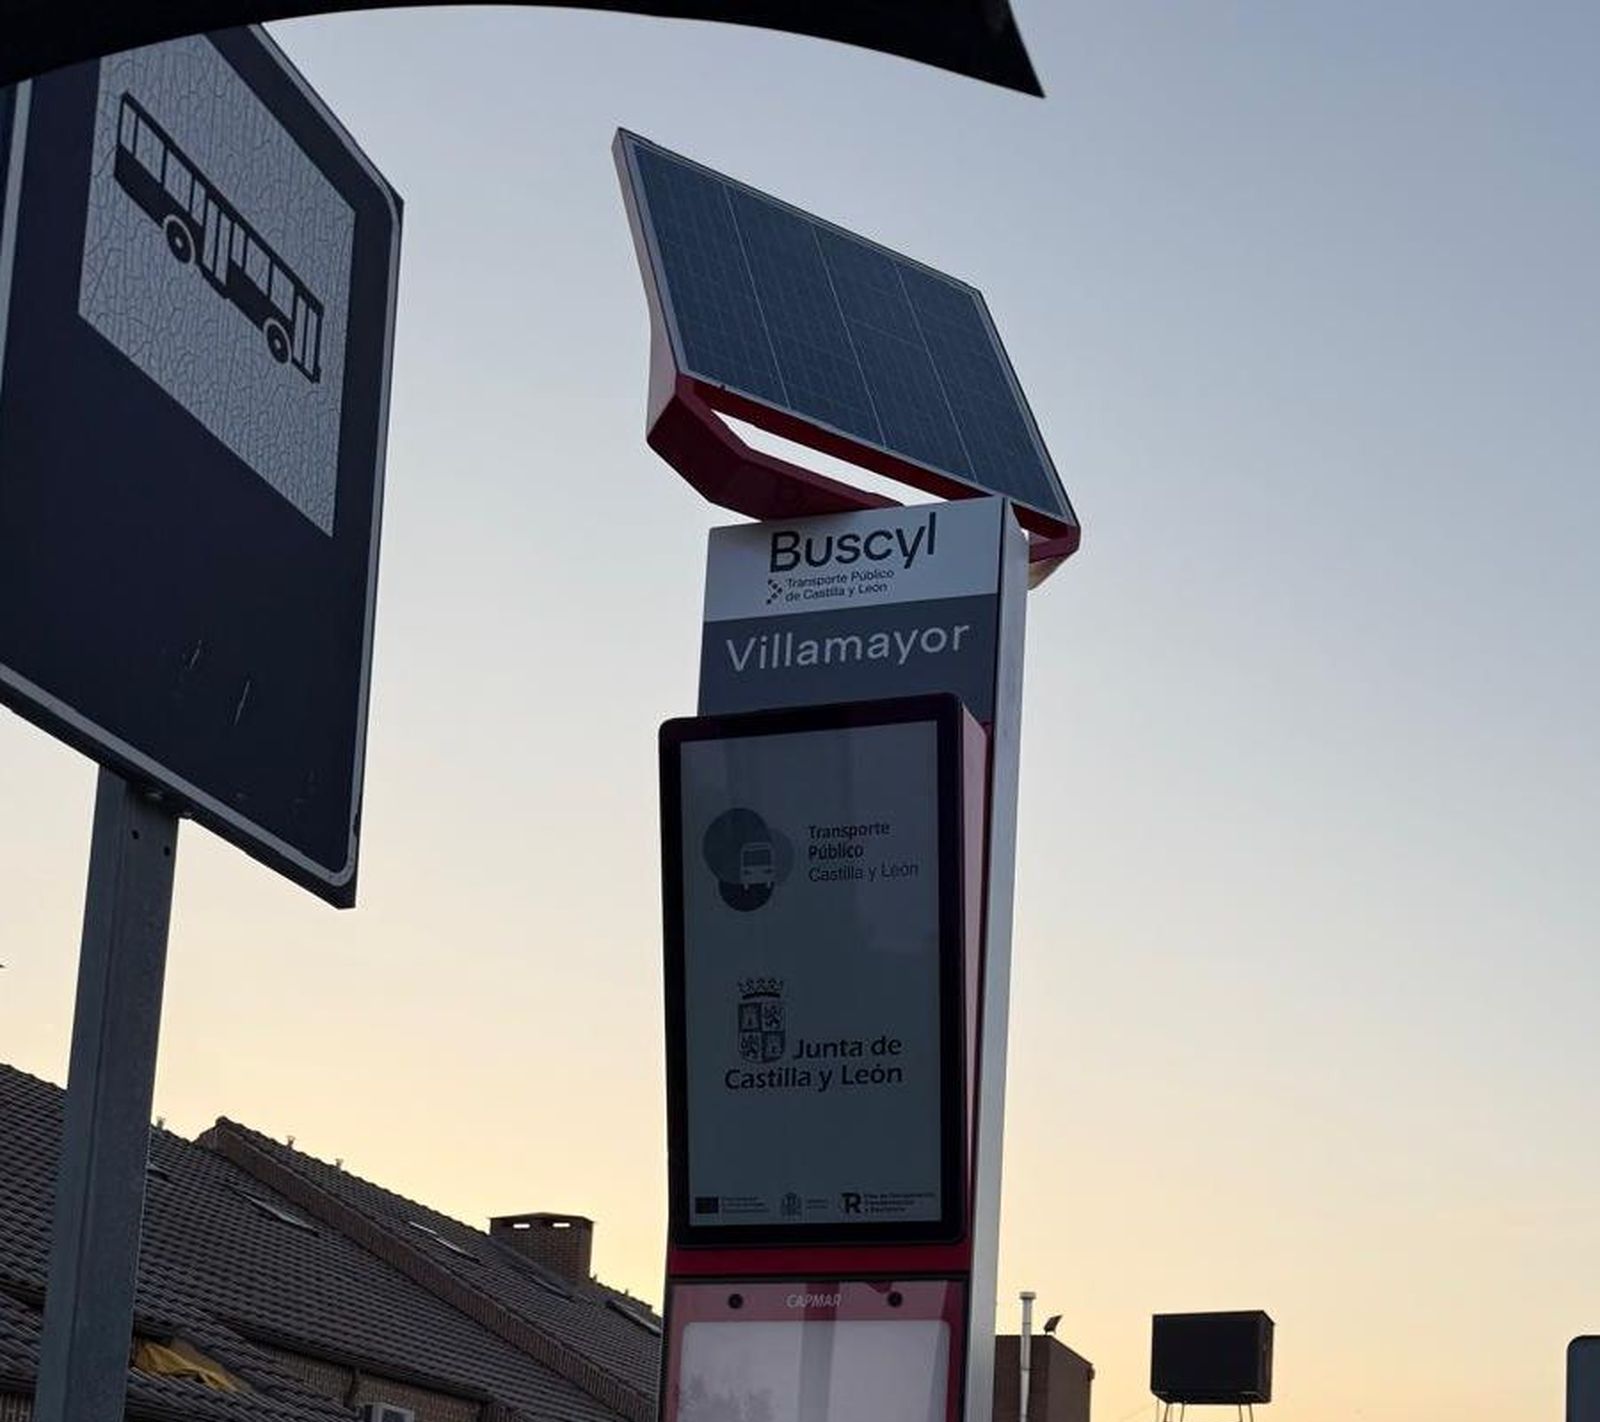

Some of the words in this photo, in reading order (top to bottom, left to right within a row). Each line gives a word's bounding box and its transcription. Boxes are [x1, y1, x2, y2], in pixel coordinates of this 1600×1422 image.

[769, 511, 936, 573] Buscyl
[786, 574, 847, 588] Transporte
[785, 592, 800, 602] de
[803, 586, 845, 600] Castilla
[848, 586, 855, 598] y
[726, 624, 969, 672] Villamayor
[808, 822, 891, 840] Transporte
[808, 842, 864, 861] Público
[808, 865, 863, 882] Castilla
[868, 866, 877, 882] y
[793, 1037, 863, 1060] Junta
[871, 1035, 902, 1055] de
[724, 1066, 811, 1090] Castilla
[818, 1069, 833, 1092] y
[842, 1063, 903, 1086] León
